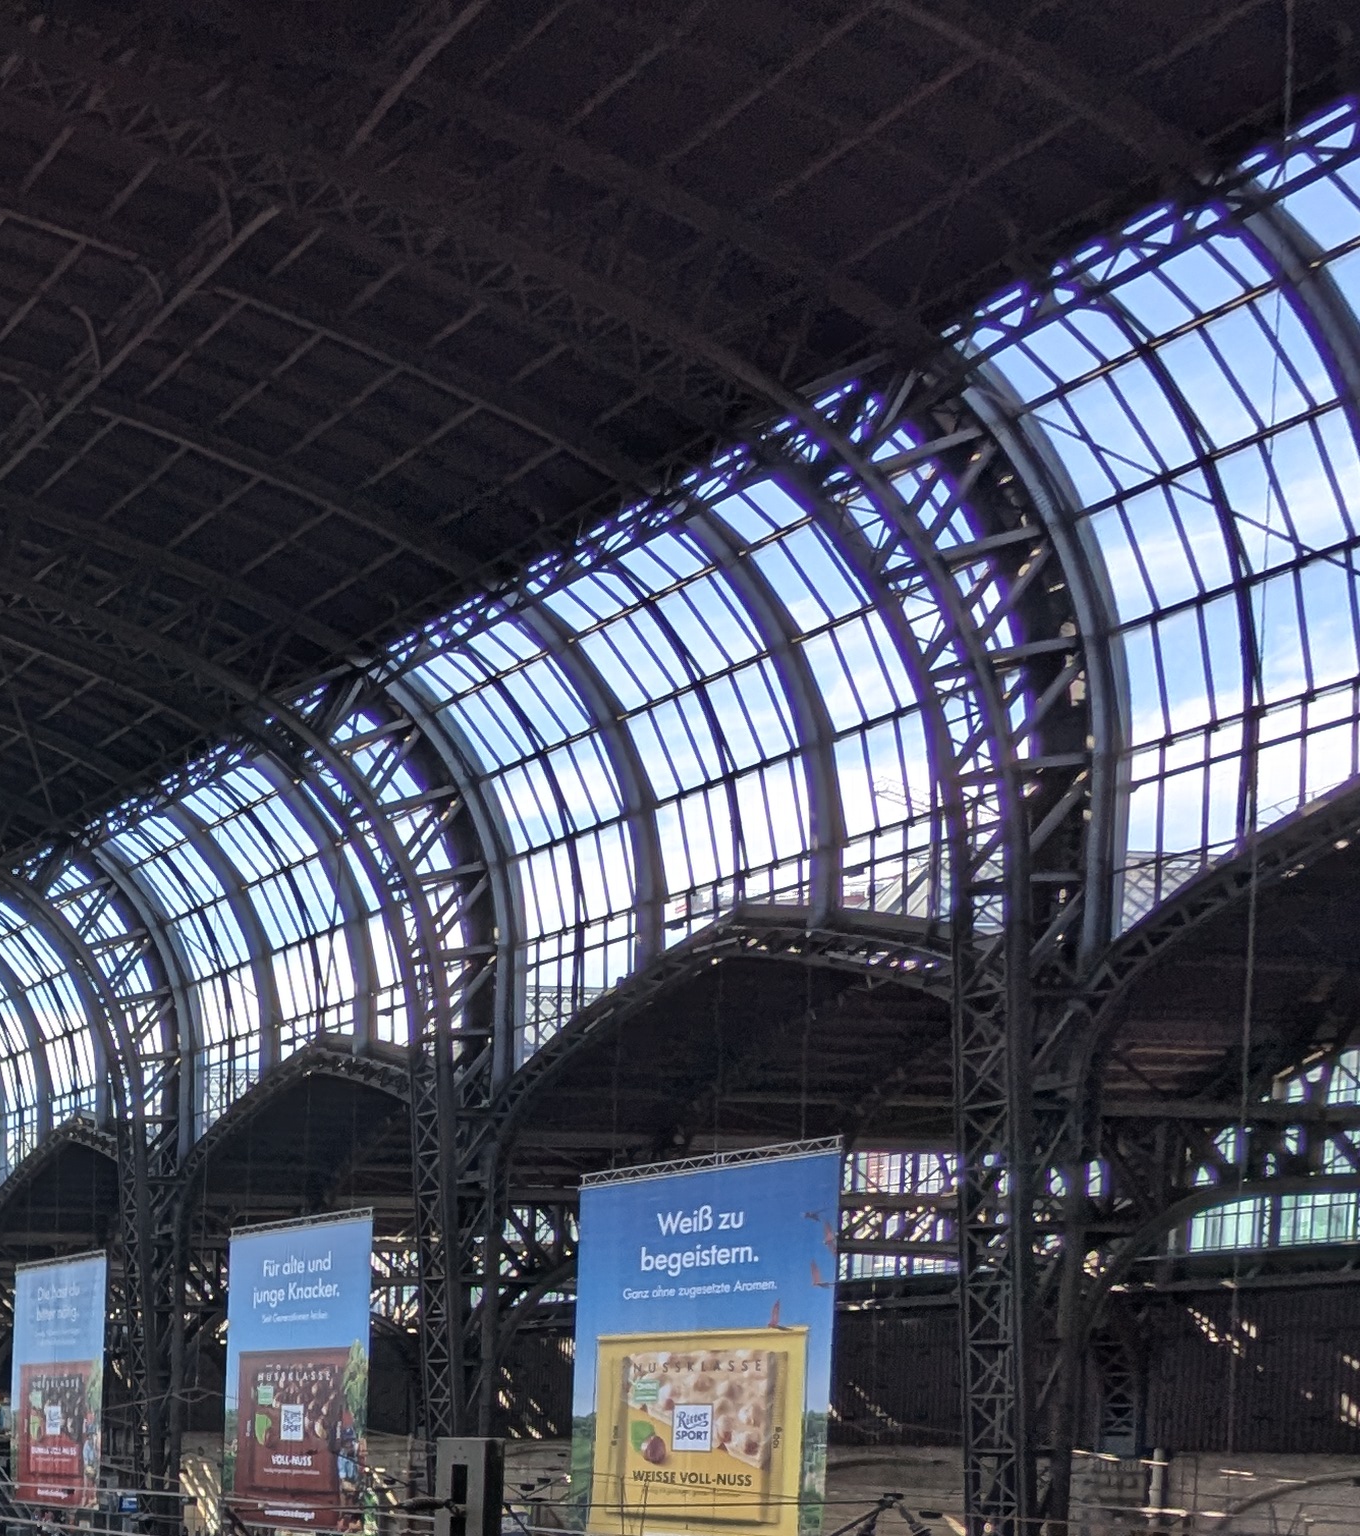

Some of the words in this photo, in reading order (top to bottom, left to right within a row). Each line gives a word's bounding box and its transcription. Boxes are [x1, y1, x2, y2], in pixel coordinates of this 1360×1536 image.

[657, 1205, 713, 1237] Weiß
[718, 1211, 744, 1230] zu
[263, 1259, 280, 1277] Für
[282, 1255, 305, 1275] alte
[308, 1250, 332, 1272] und
[641, 1244, 759, 1277] begeistern.
[37, 1286, 50, 1301] Die
[252, 1287, 285, 1309] junge
[288, 1278, 340, 1300] Knacker.
[623, 1288, 649, 1301] Ganz
[652, 1285, 675, 1298] ohne
[678, 1282, 731, 1298] zugesetzte
[733, 1280, 777, 1292] Aromen.
[633, 1359, 762, 1373] NUSSKLASSE
[257, 1371, 332, 1382] NUSSKLASSE
[676, 1411, 709, 1430] Ritter
[675, 1430, 709, 1441] SPORT
[271, 1454, 312, 1467] VOLL-NUSS
[632, 1470, 676, 1484] WEISSE
[680, 1472, 752, 1487] VOLL-NUSS
